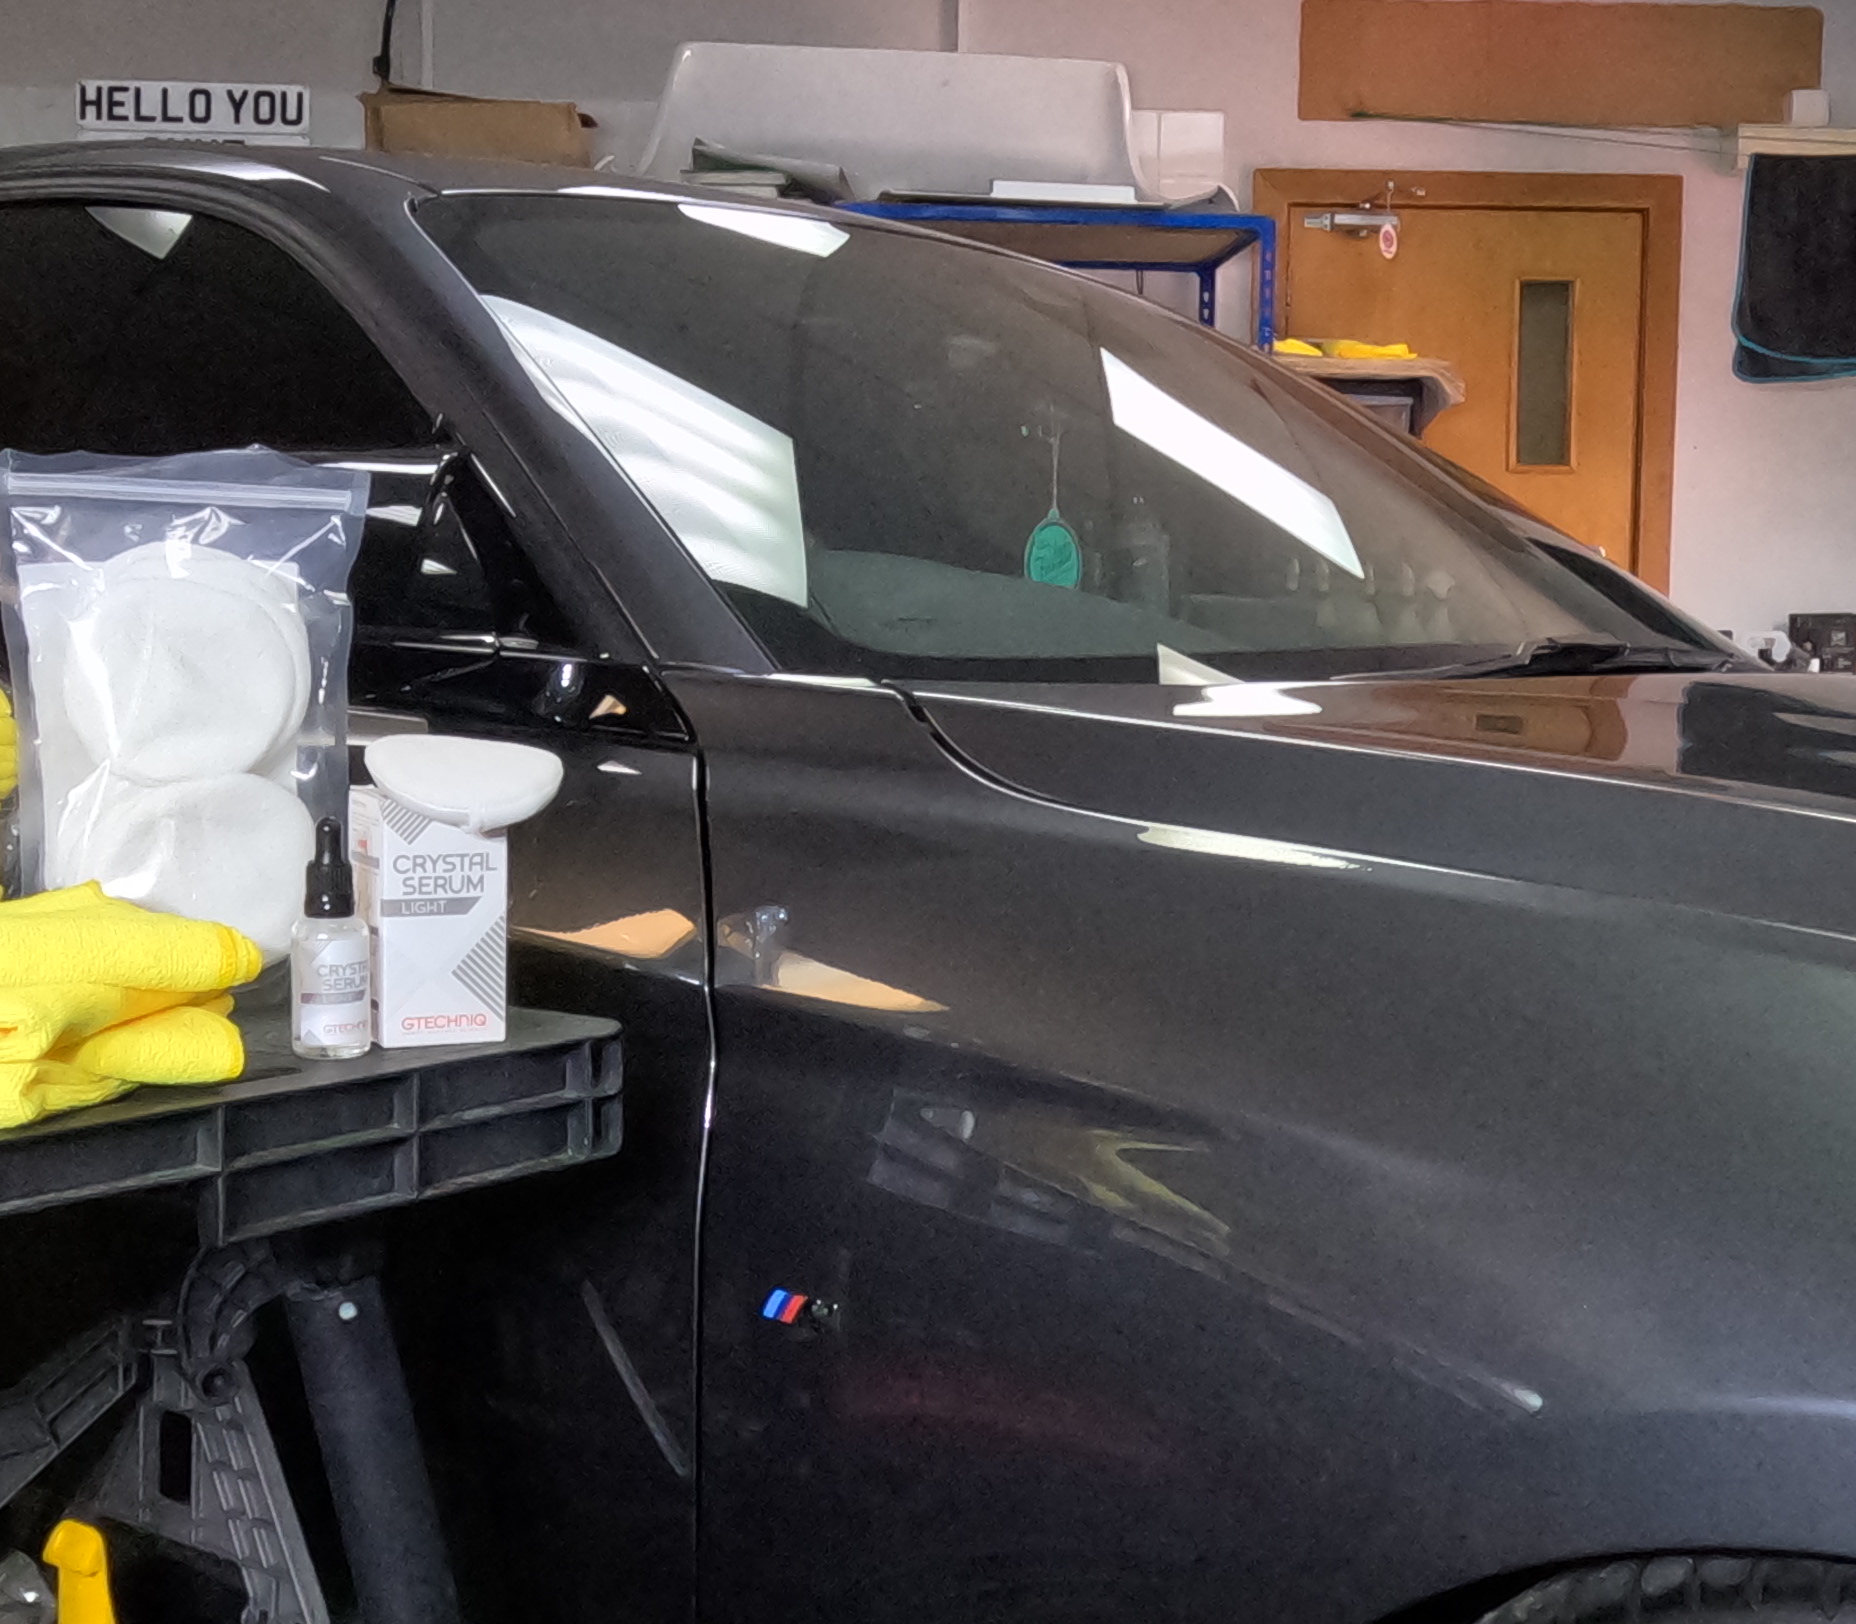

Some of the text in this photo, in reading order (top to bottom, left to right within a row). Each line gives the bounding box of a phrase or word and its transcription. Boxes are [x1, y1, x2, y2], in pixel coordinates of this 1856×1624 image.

[79, 84, 305, 127] HELLO YOU
[392, 851, 498, 876] CRYSTAL
[401, 875, 485, 896] SERUM
[400, 900, 448, 915] LIGHT
[400, 1013, 488, 1031] GTECHNIQ
